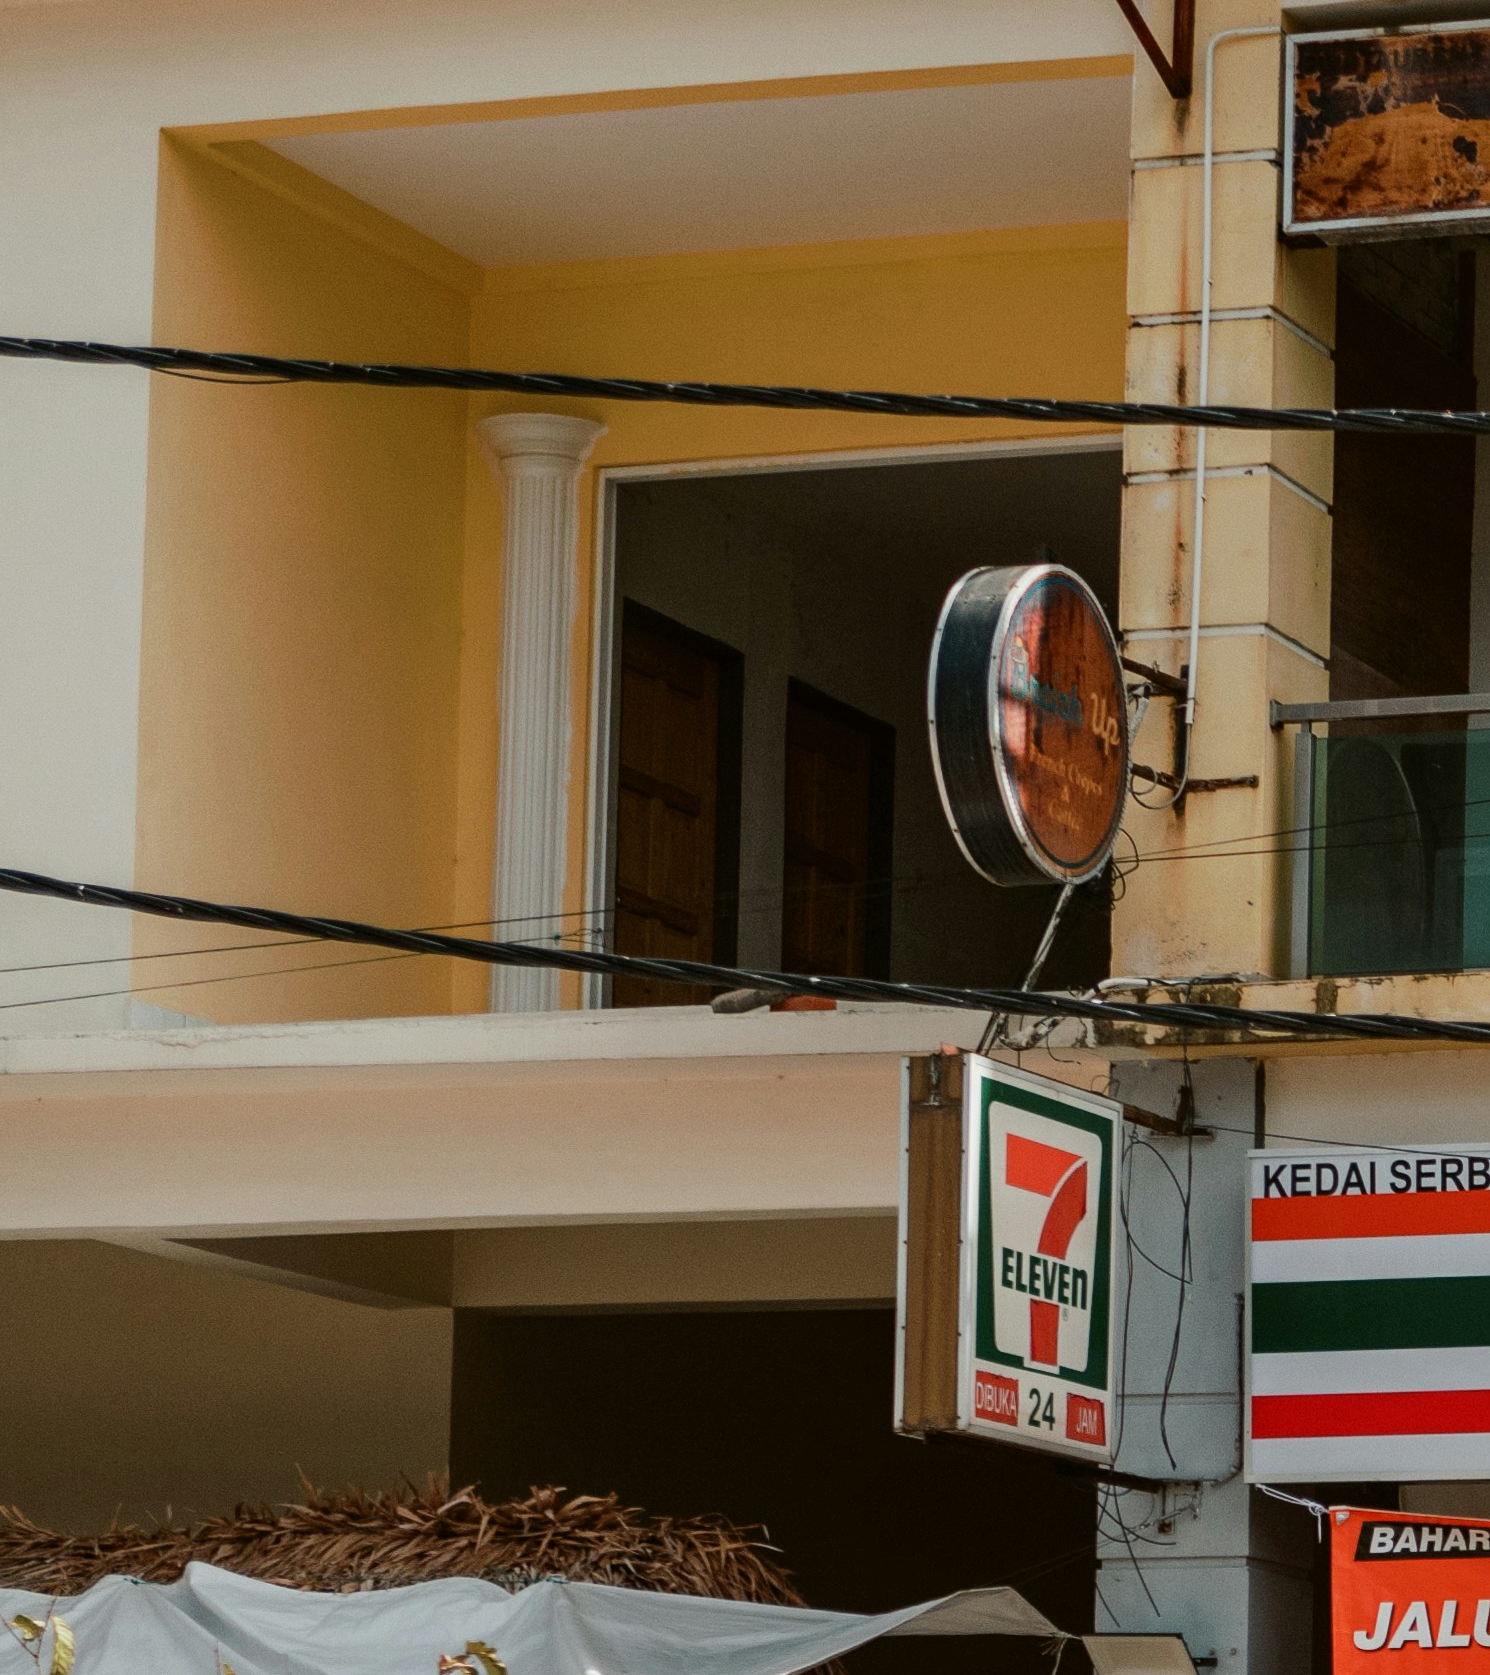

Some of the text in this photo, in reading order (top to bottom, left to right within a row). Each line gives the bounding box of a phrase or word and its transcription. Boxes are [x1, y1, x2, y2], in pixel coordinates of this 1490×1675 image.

[1264, 1161, 1376, 1198] KEDAI
[1005, 1133, 1087, 1366] 7
[976, 1381, 1098, 1437] DIBUKA 24 JAM
